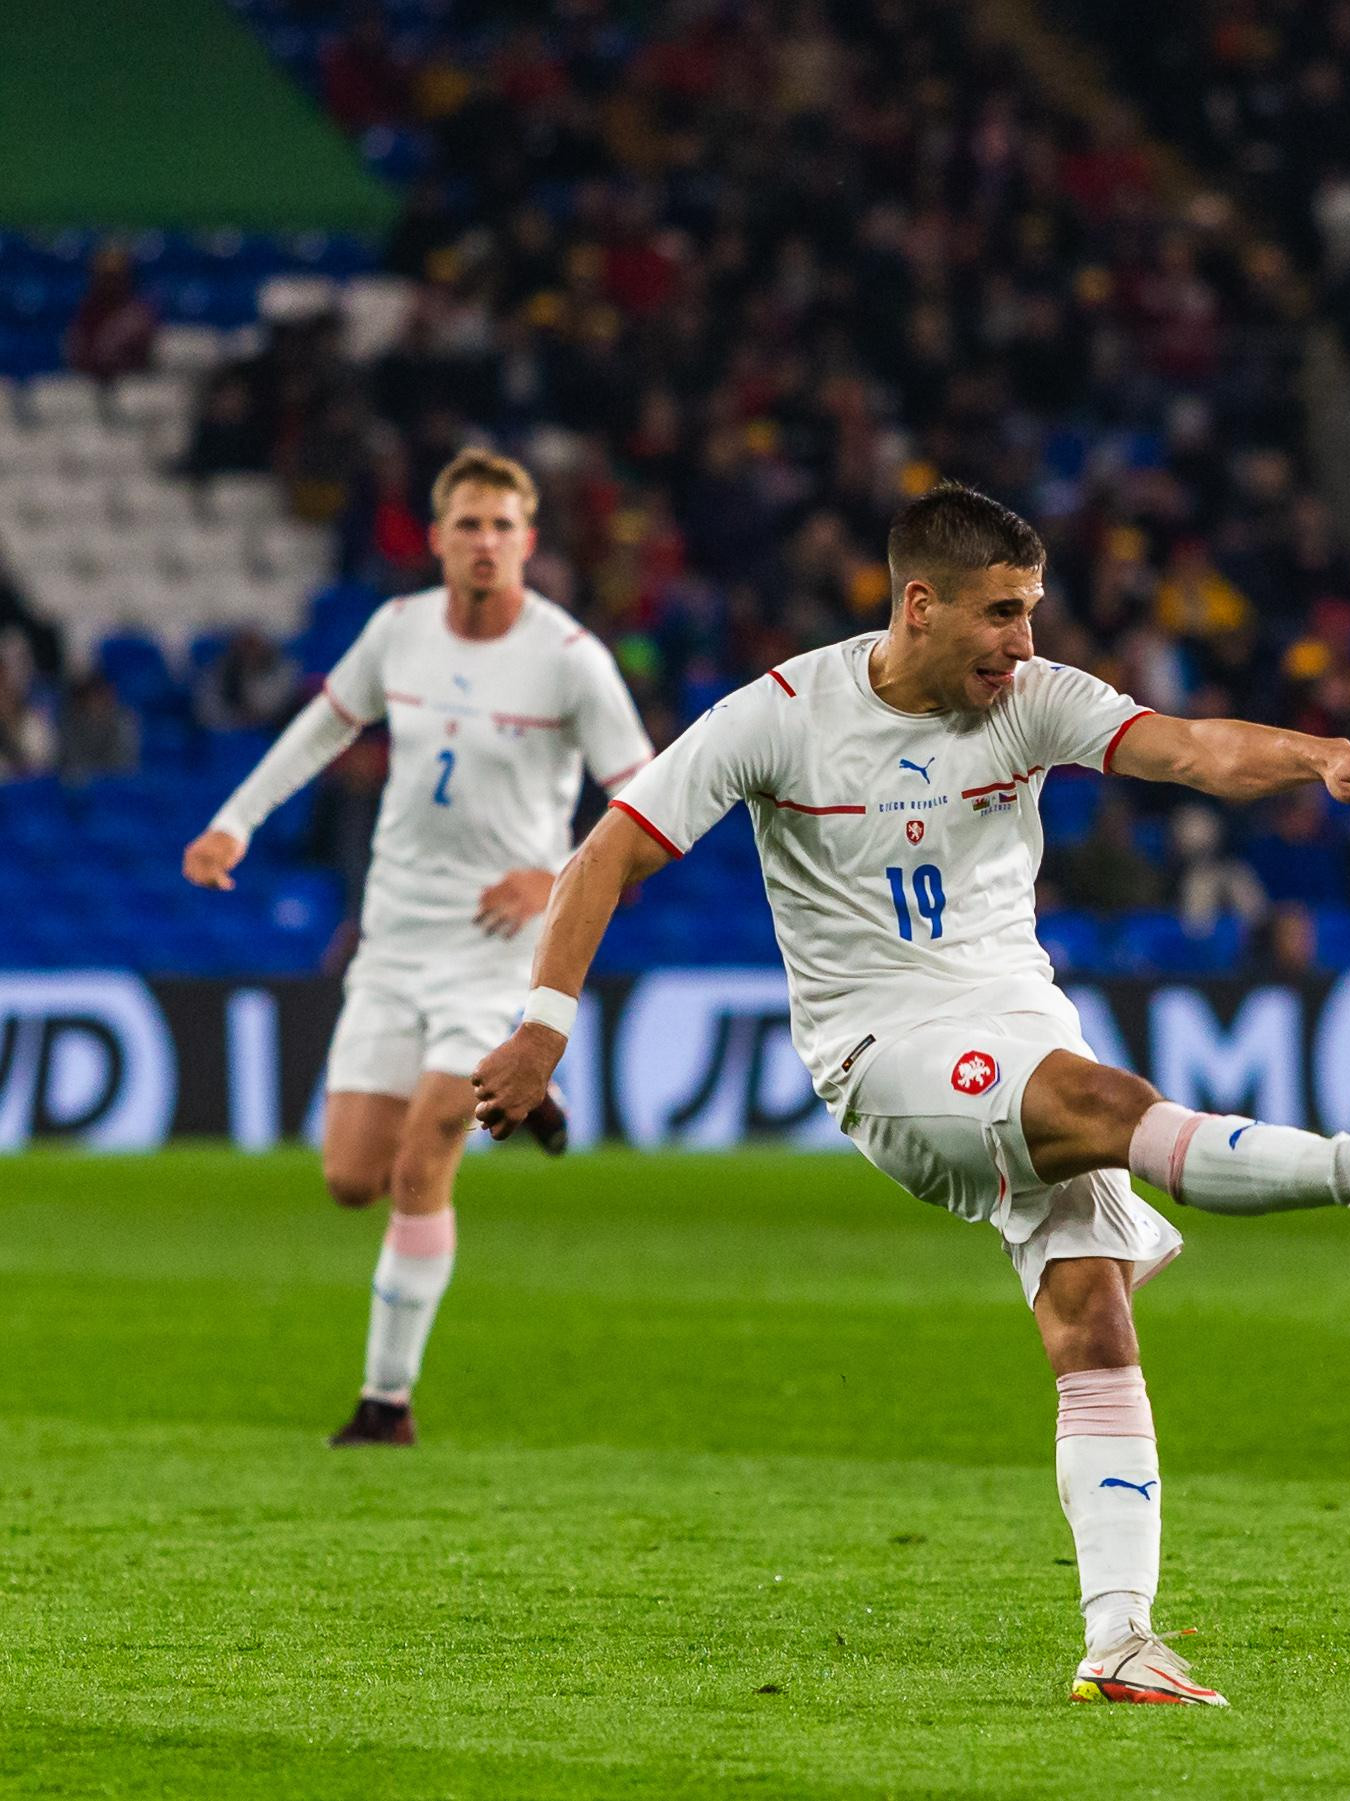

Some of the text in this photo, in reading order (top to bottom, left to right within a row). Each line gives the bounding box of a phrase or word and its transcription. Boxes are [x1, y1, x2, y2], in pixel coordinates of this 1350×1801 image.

[432, 748, 457, 806] 2
[911, 795, 948, 810] REPBLIC
[886, 863, 946, 941] 19
